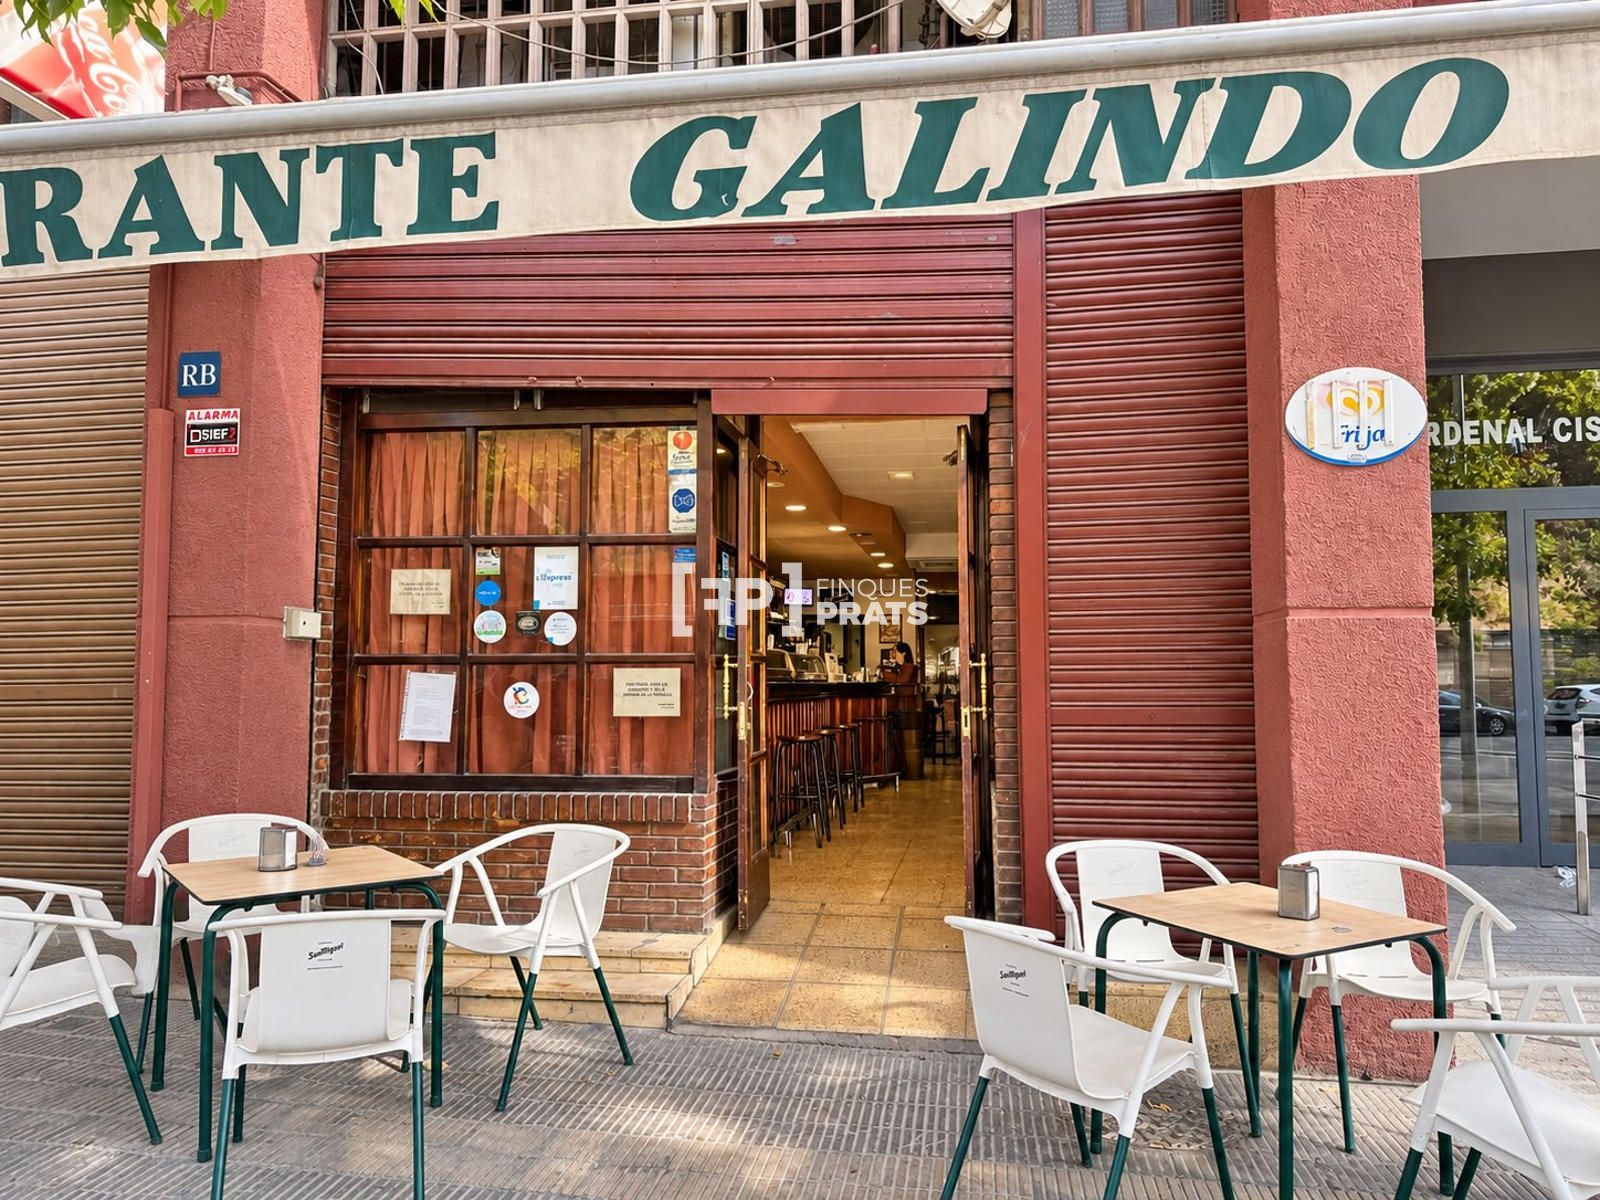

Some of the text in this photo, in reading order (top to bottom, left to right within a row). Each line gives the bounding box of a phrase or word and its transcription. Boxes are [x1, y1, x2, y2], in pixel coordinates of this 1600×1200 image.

[0, 57, 1510, 267] RANTE GALINDO
[182, 363, 216, 387] RB
[188, 410, 238, 421] ALARMA
